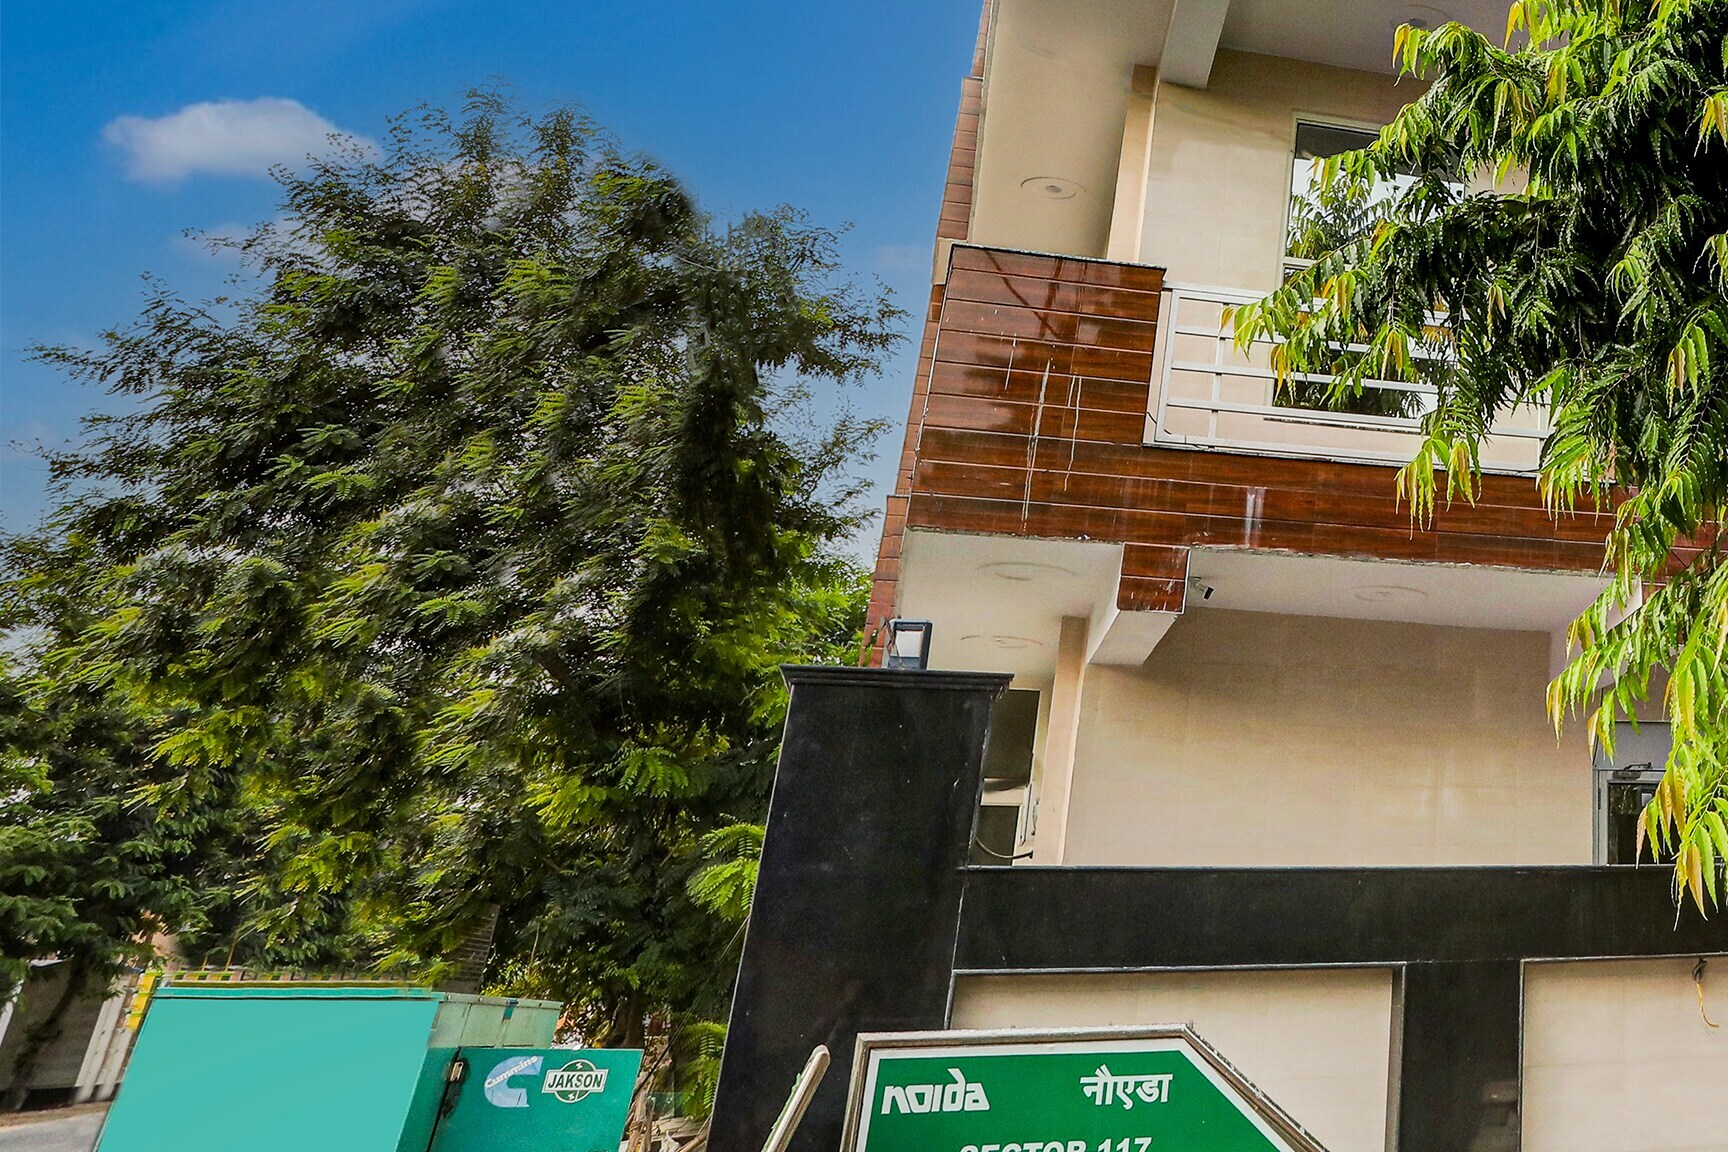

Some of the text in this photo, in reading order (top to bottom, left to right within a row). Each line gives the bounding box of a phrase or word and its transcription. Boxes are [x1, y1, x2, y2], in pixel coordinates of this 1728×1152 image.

[485, 1055, 539, 1089] Cummins
[547, 1073, 604, 1089] JAKSON
[1080, 1064, 1174, 1110] नौएडा
